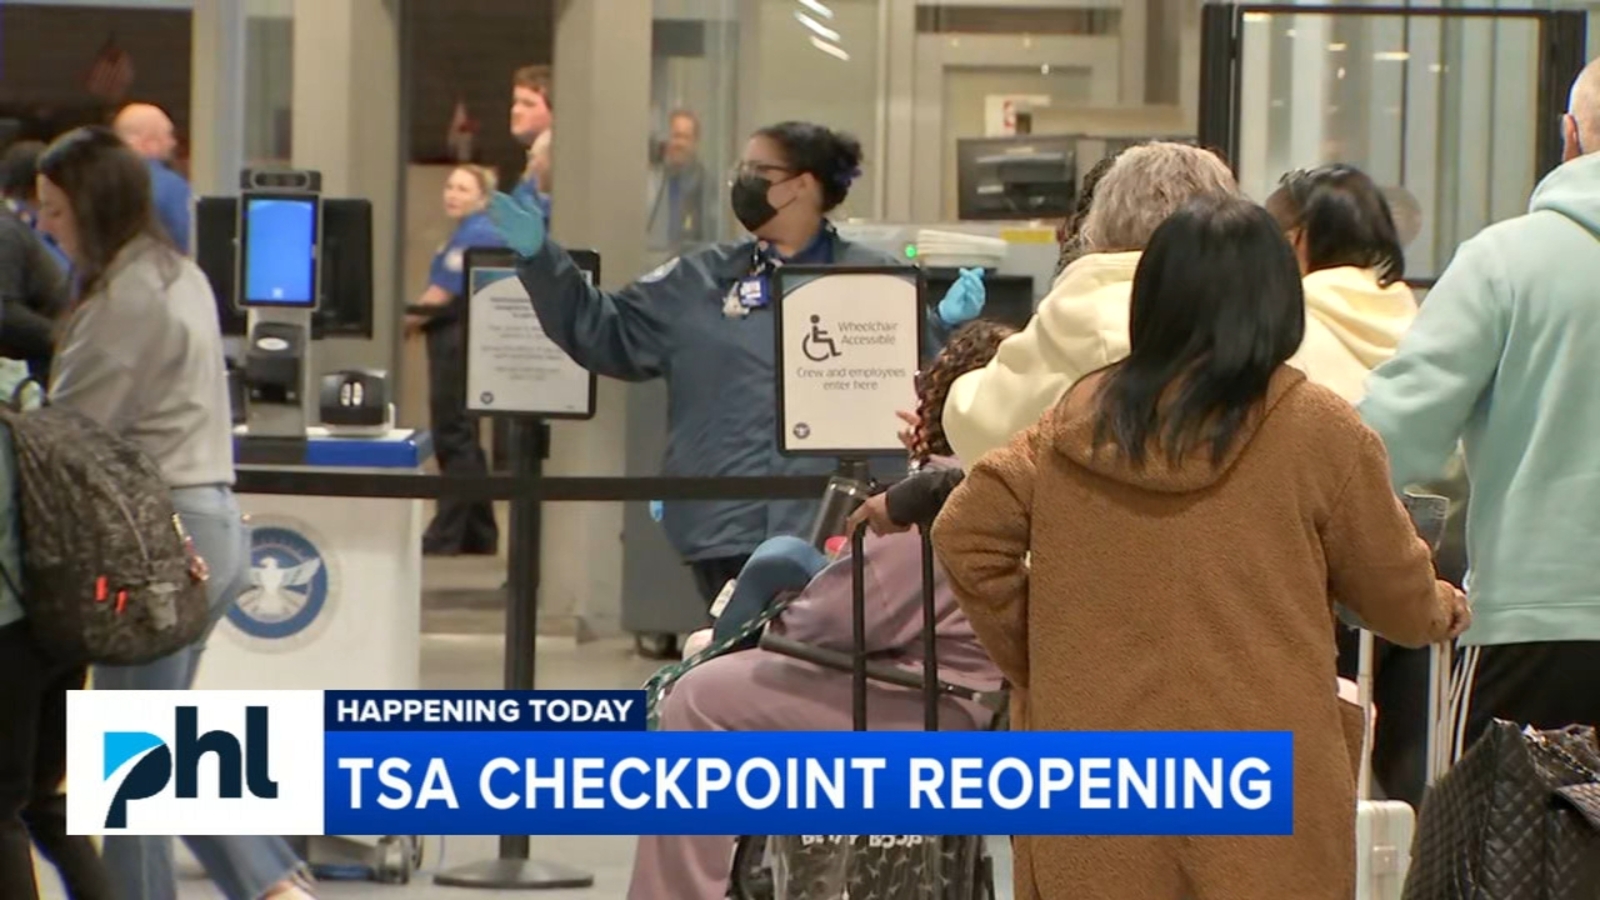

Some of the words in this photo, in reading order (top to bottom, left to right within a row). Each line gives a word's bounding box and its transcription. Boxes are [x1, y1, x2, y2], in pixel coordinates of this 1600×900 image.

[838, 321, 898, 332] Wheelchair
[841, 334, 897, 345] Accessible
[797, 367, 824, 378] Crew
[825, 367, 847, 378] and
[848, 367, 906, 379] employees
[822, 380, 851, 390] enter
[853, 379, 879, 390] here
